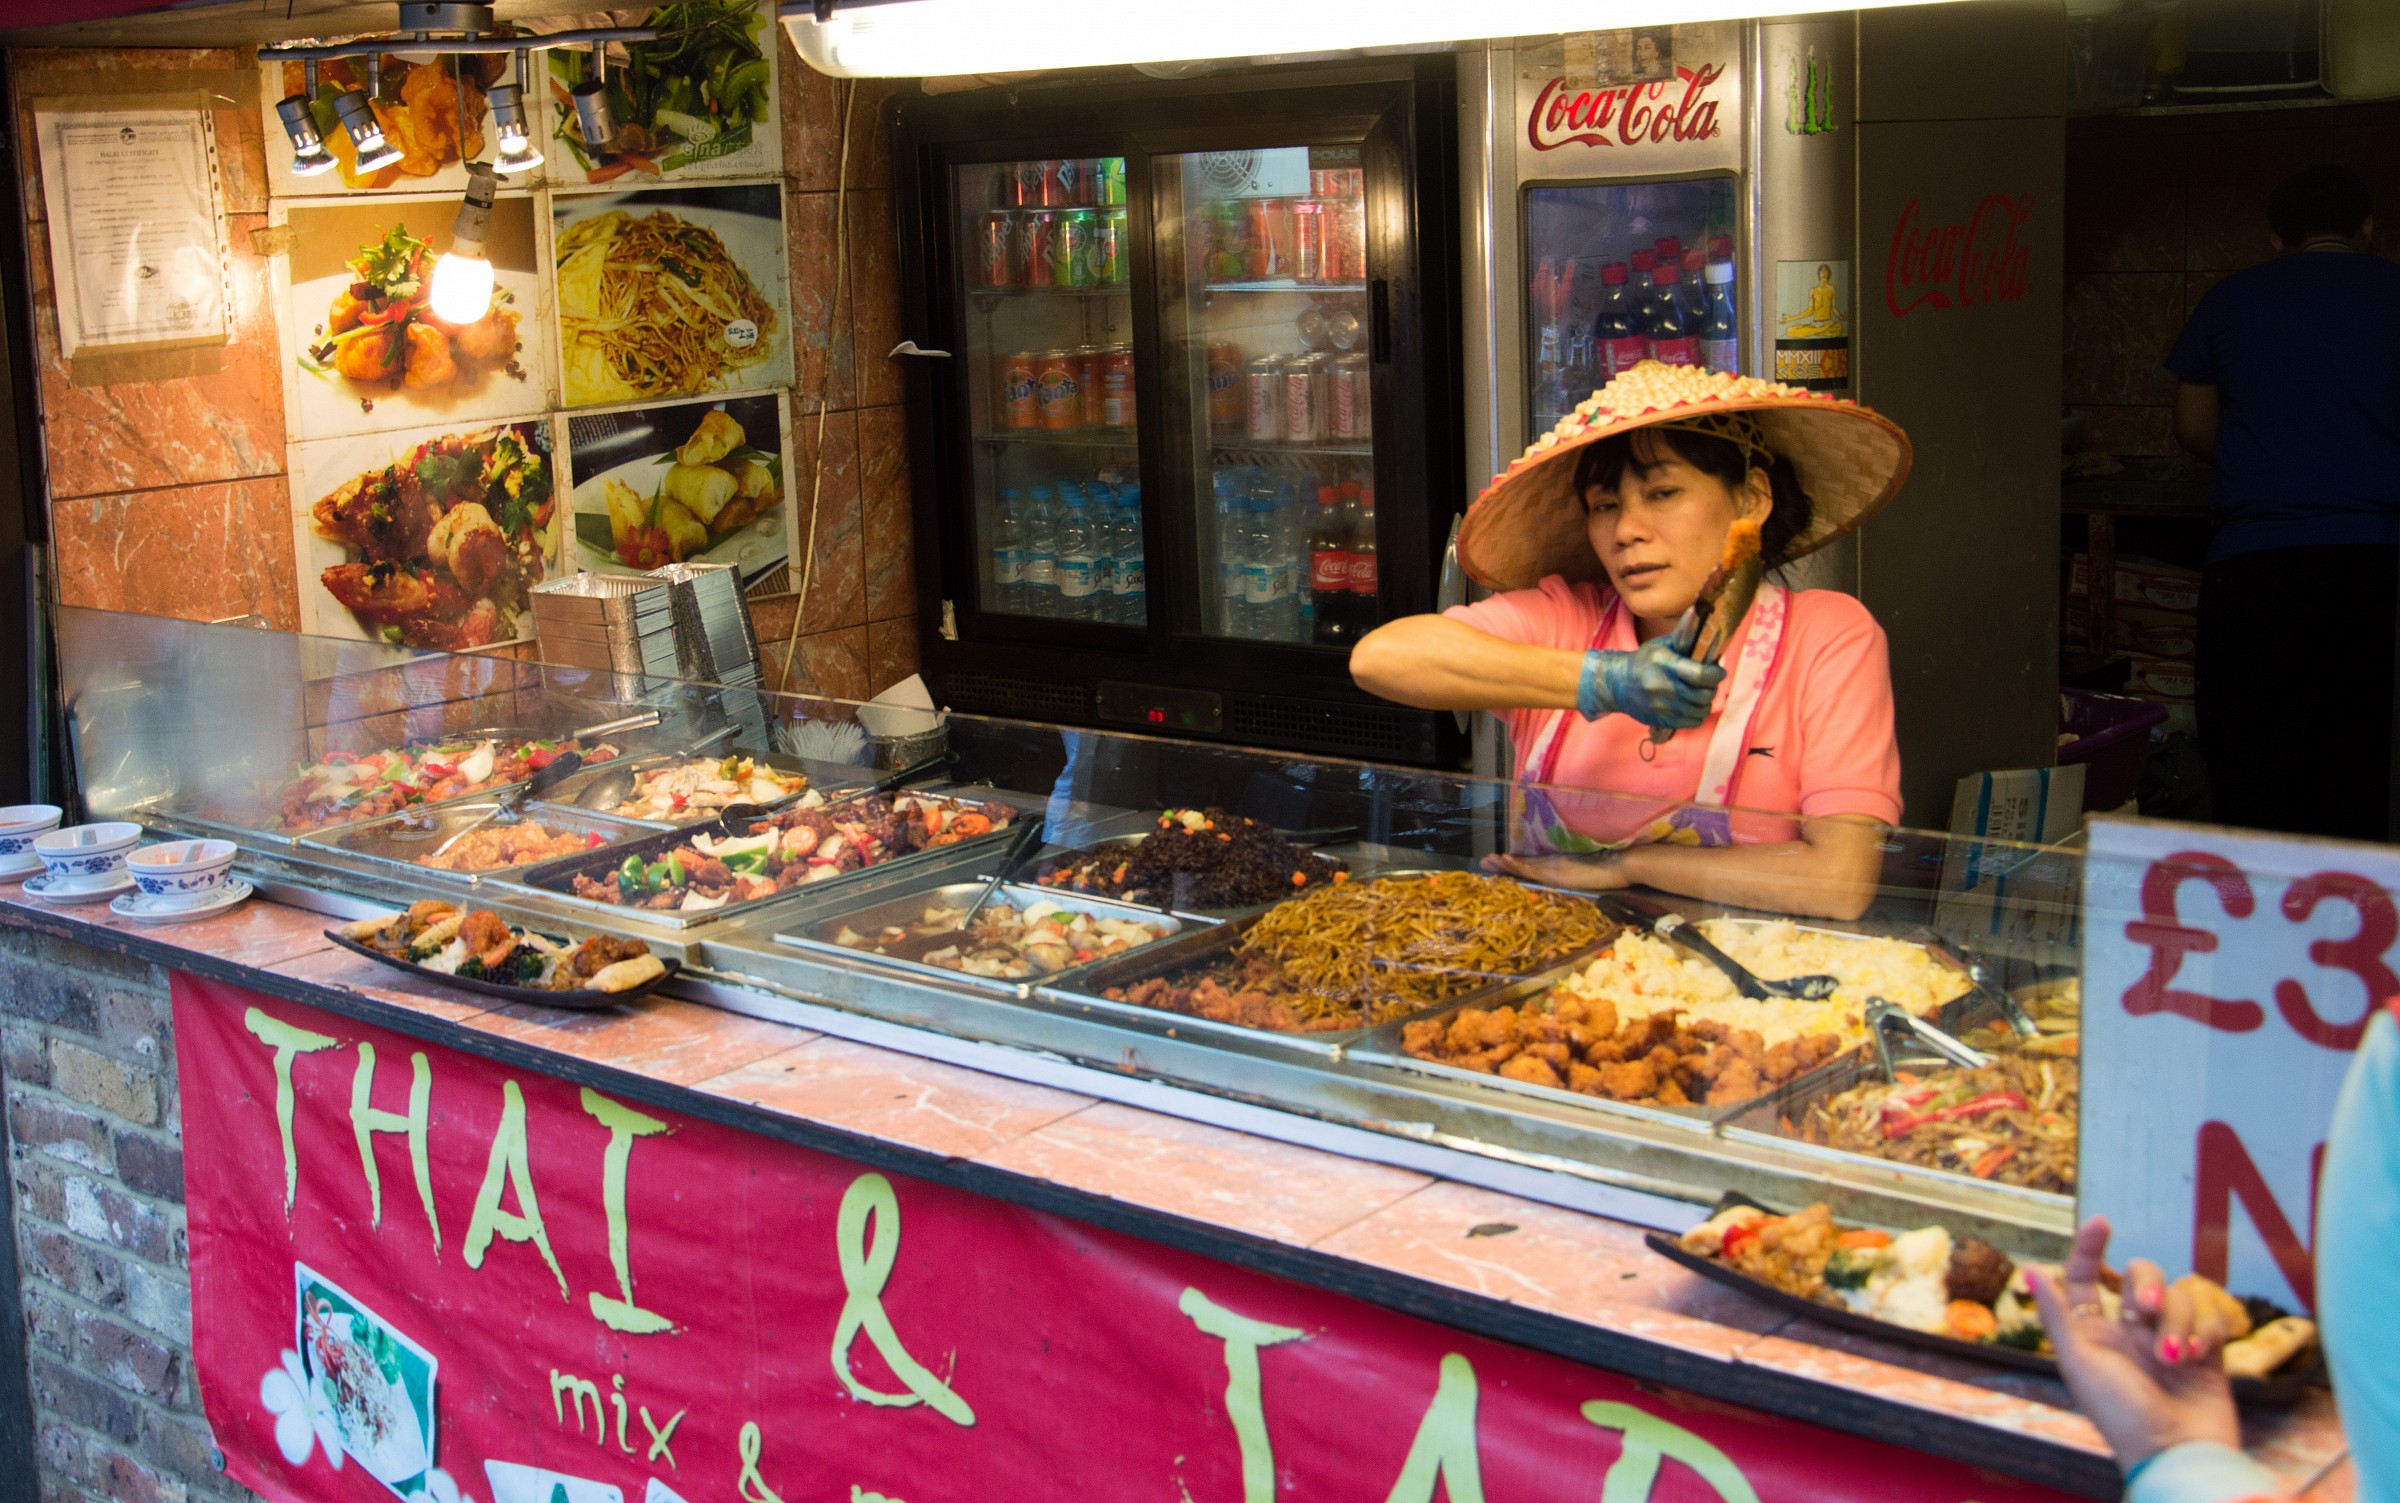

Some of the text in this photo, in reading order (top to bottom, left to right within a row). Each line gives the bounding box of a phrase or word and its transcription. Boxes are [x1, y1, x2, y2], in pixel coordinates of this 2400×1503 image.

[1528, 62, 1736, 151] Coca-Cola
[1885, 191, 2037, 318] Coca-Cola
[244, 1006, 684, 1335] THAI
[830, 1172, 978, 1428] &
[549, 1367, 786, 1503] mix &
